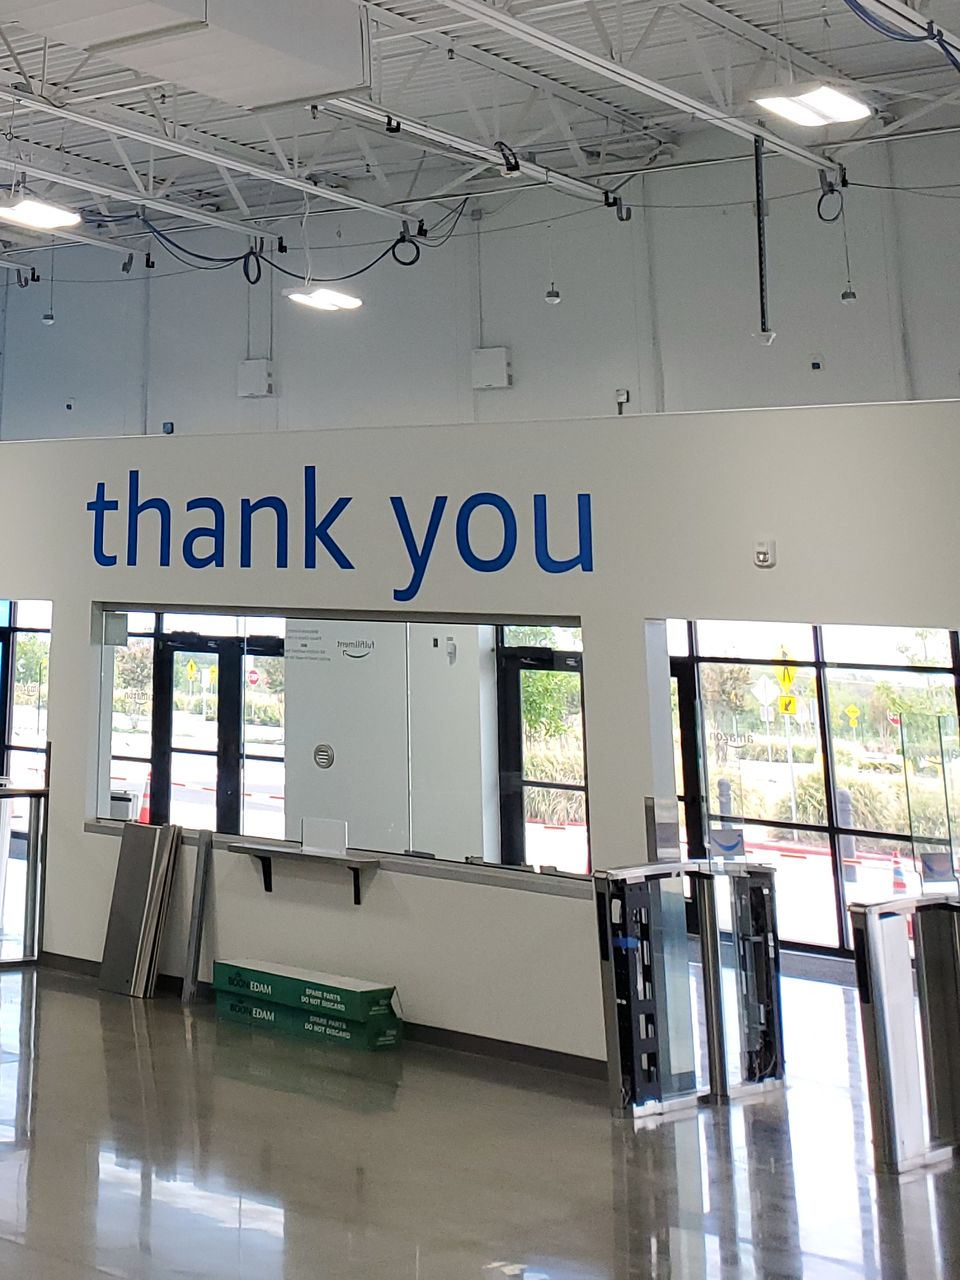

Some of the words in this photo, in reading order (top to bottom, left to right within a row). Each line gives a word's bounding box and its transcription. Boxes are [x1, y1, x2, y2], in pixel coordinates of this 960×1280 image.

[86, 465, 355, 570] thank
[389, 492, 594, 602] you
[301, 996, 309, 1004] DO
[310, 998, 321, 1006] NOT
[322, 1000, 345, 1011] DISCARD
[323, 992, 341, 1002] PARTS
[304, 1023, 313, 1031] DO
[313, 1024, 325, 1033] NOT
[326, 1027, 351, 1038] DISCARD
